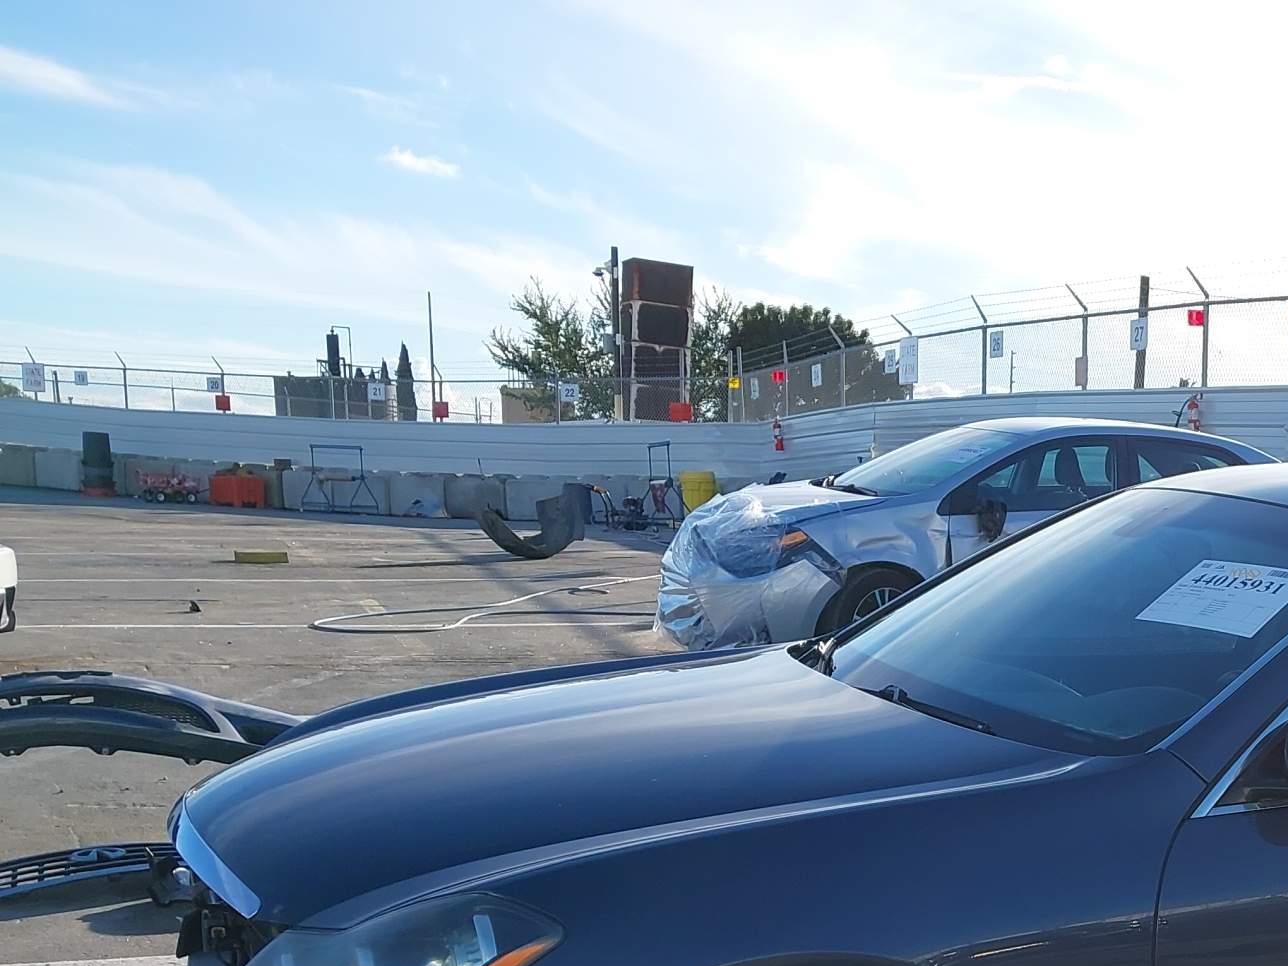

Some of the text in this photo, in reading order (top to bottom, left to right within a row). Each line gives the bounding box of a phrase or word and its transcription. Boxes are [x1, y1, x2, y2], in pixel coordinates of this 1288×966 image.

[1134, 326, 1144, 342] 27
[992, 337, 1001, 351] 26
[210, 380, 219, 390] 20
[373, 387, 382, 396] 21
[564, 388, 575, 398] 22
[1191, 572, 1286, 595] 44015931
